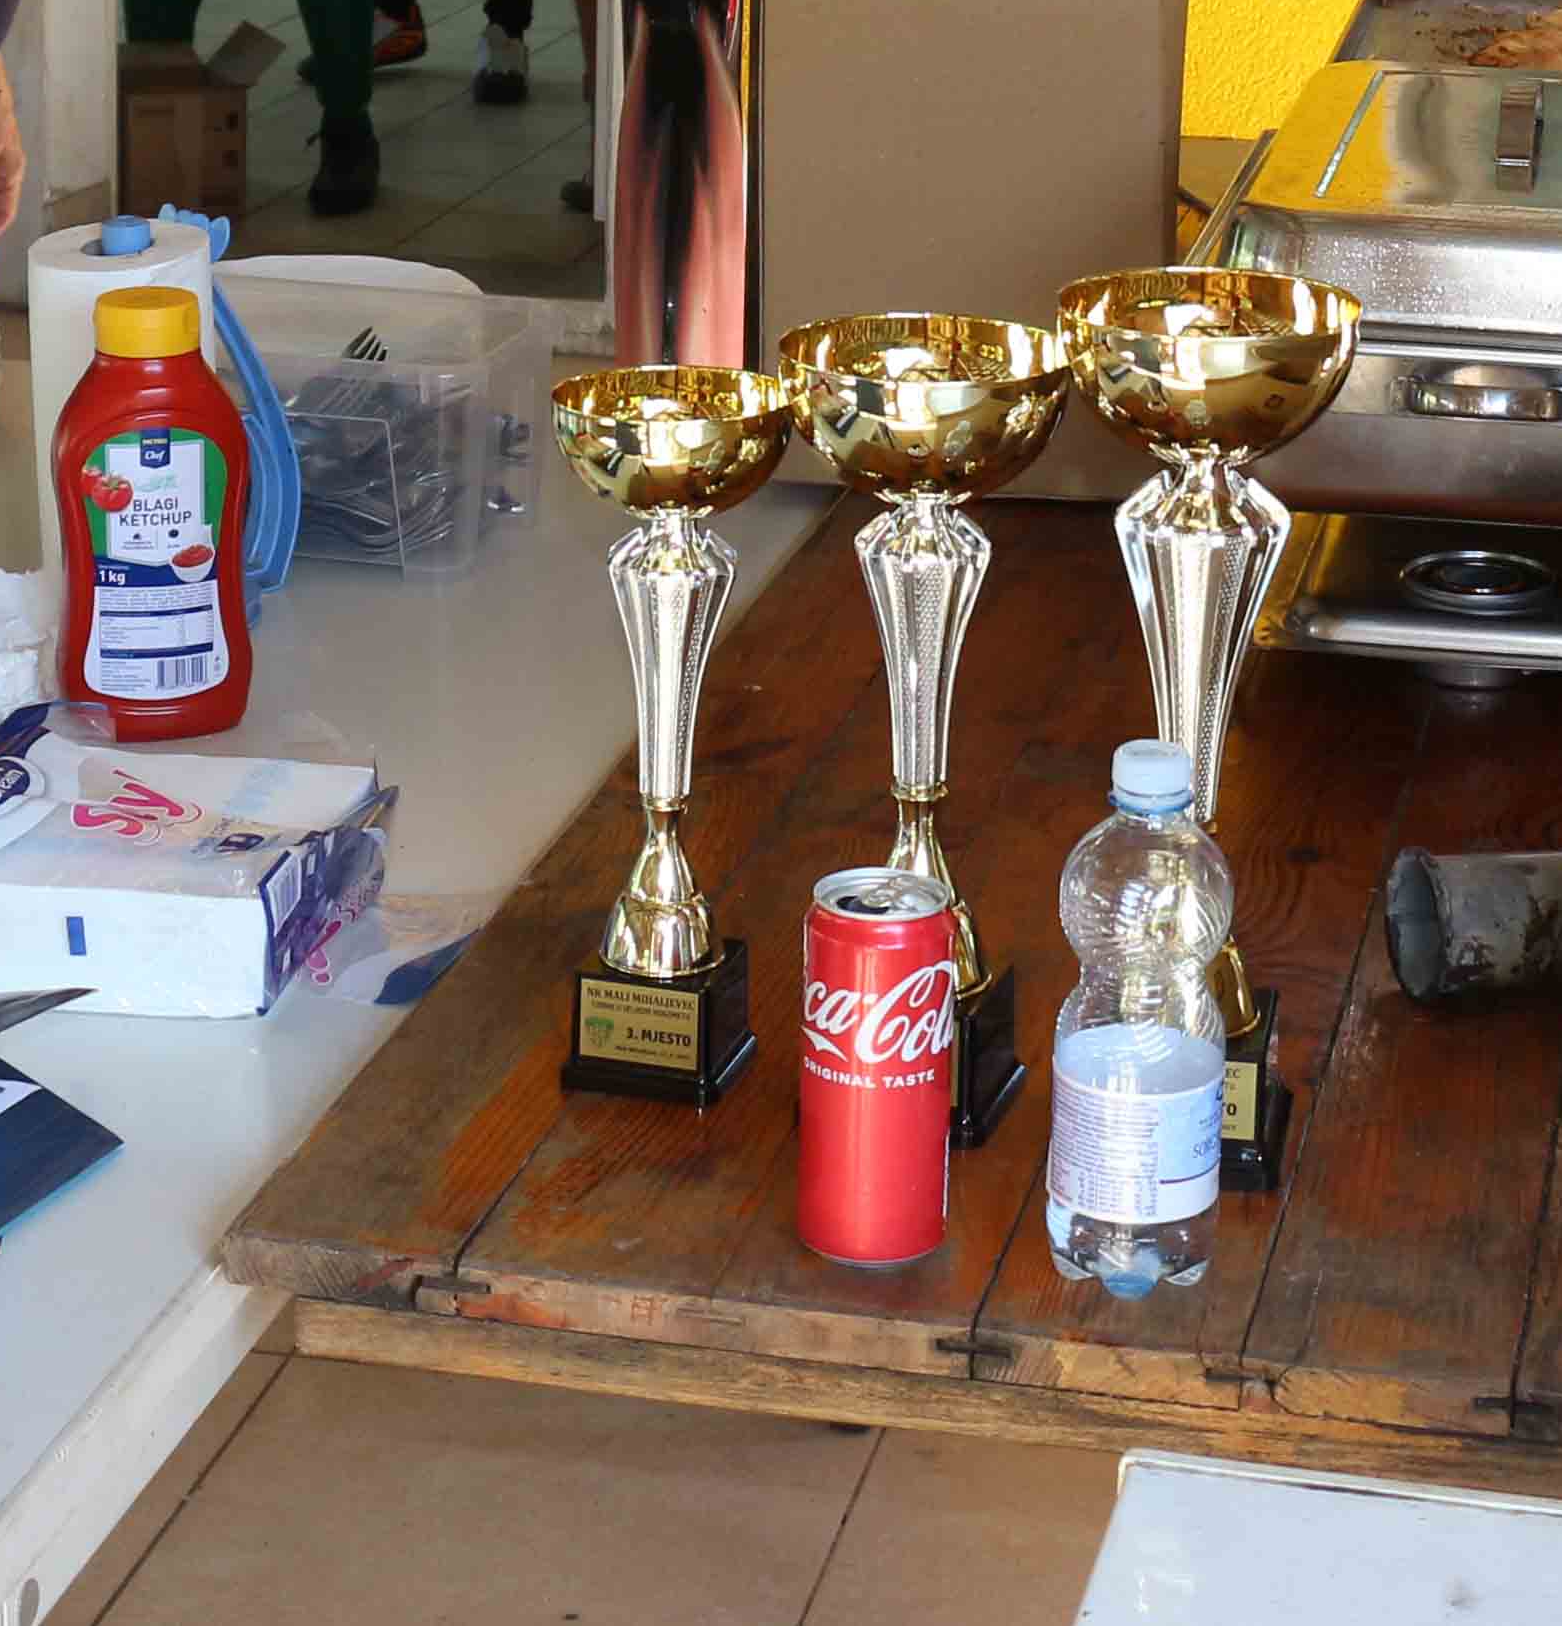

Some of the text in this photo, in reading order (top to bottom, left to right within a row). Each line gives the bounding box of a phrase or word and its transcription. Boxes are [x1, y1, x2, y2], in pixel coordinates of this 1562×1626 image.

[133, 497, 178, 512] BLAGI
[119, 511, 192, 526] KETCHUP
[99, 570, 126, 586] 1 kg
[641, 1027, 692, 1047] MJESTO
[882, 1068, 935, 1089] TASTE
